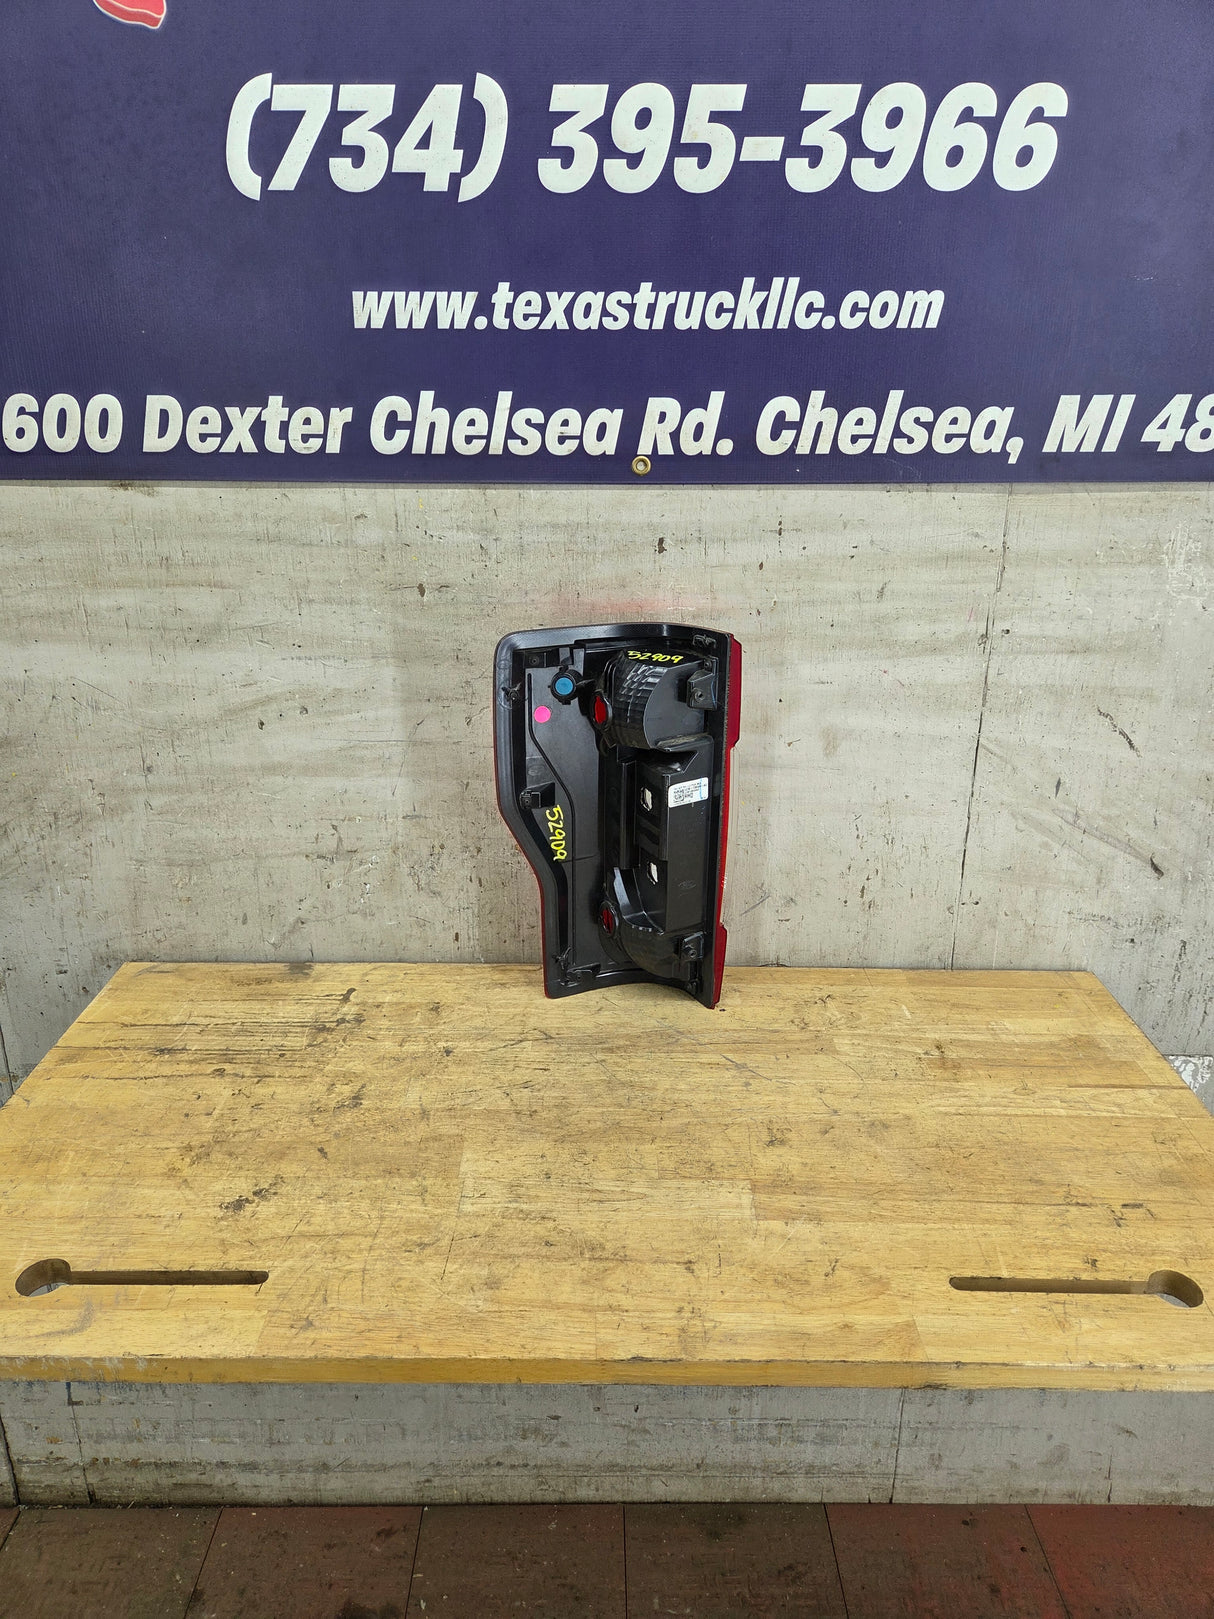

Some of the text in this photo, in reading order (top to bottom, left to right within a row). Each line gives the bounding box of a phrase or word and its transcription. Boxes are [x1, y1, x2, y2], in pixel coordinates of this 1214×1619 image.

[225, 71, 1069, 203] (734) 395-3966
[351, 276, 945, 331] www.texastruckllc.com
[1, 389, 1214, 465] 600 Dexter Chelsea Rd. Chelsea, MI 48
[627, 650, 684, 664] 52909
